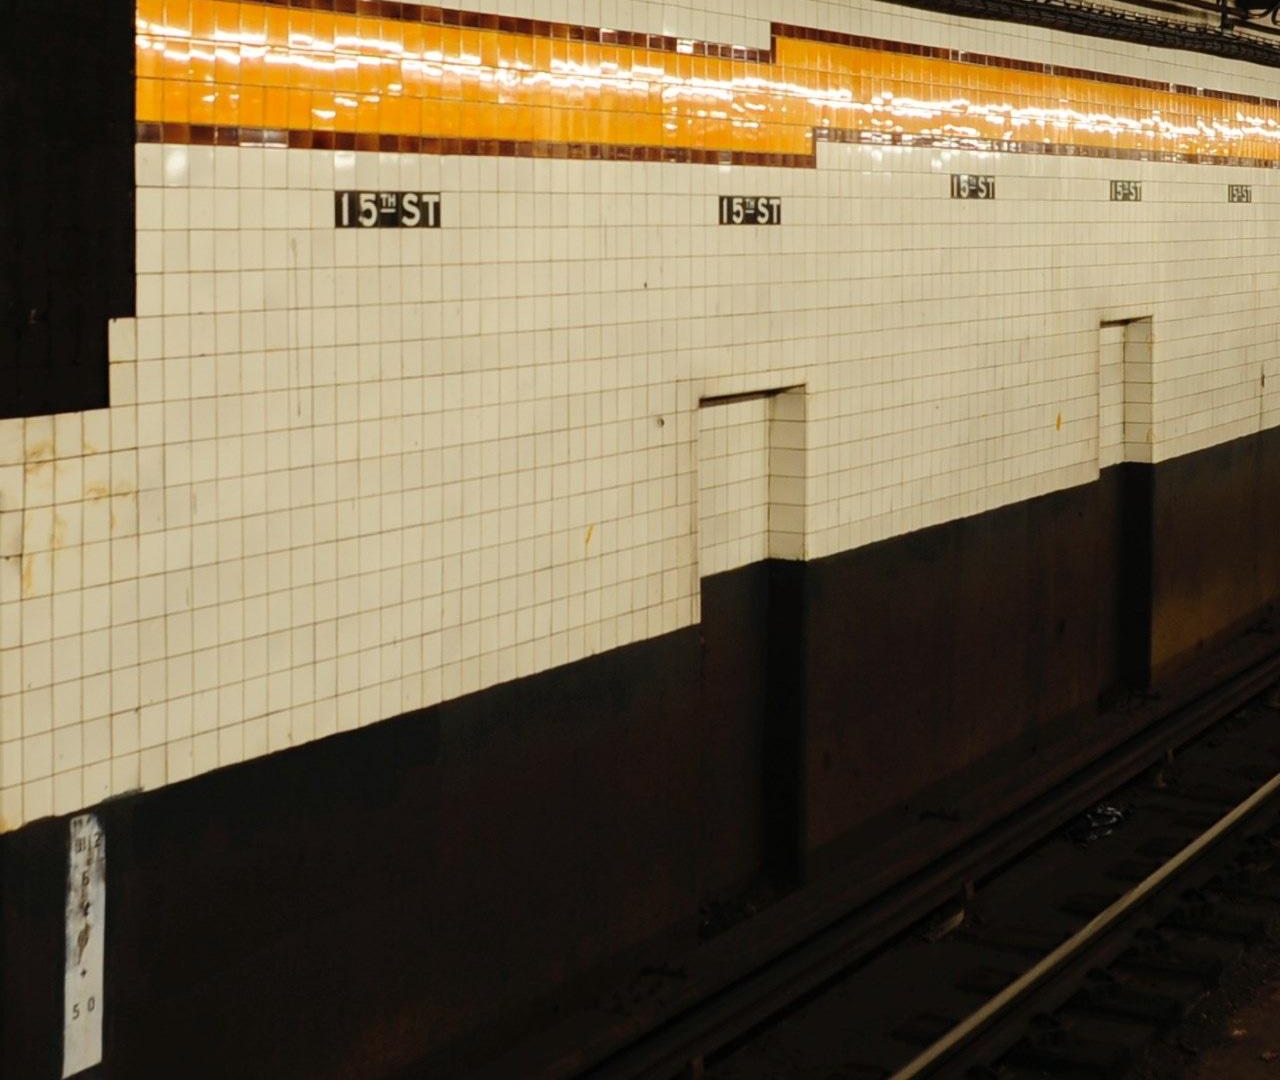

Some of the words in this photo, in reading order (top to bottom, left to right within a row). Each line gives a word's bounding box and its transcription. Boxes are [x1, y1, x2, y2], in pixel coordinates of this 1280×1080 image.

[977, 175, 994, 198] ST
[341, 192, 397, 227] 15TH
[401, 192, 440, 227] ST
[756, 197, 781, 224] ST
